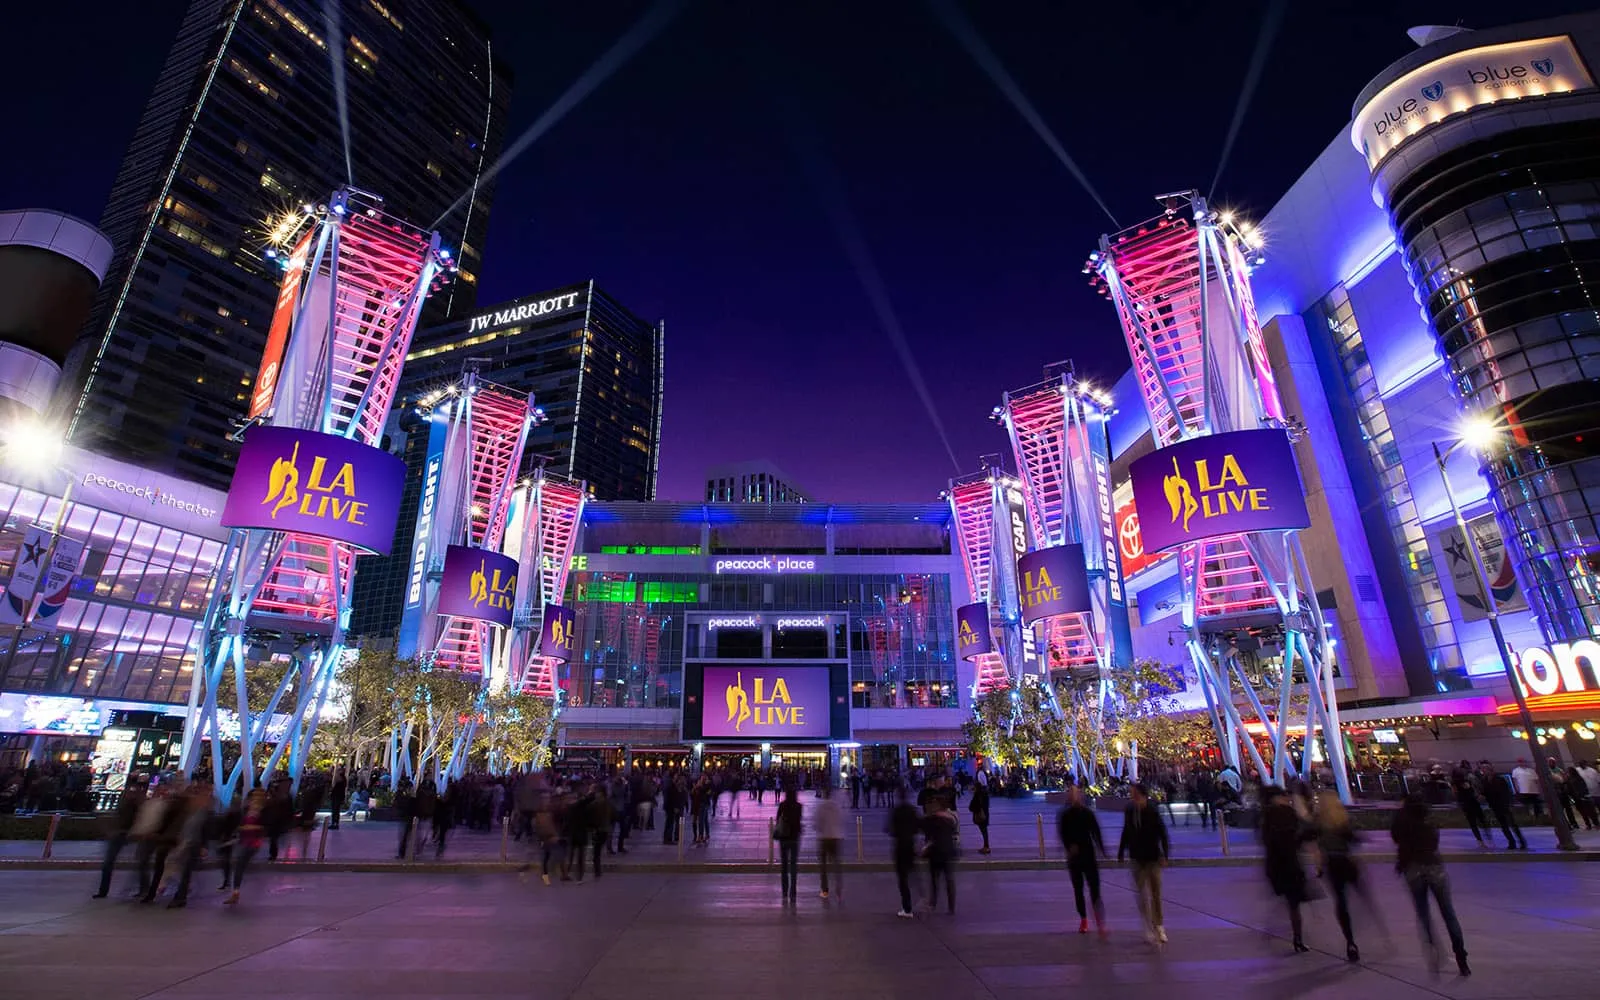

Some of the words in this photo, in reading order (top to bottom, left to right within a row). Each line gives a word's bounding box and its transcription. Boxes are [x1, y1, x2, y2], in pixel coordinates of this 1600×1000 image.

[1467, 65, 1528, 85] blue
[1484, 78, 1540, 90] california
[1374, 98, 1417, 136] blue
[1385, 107, 1429, 137] california
[468, 314, 493, 333] JW
[493, 292, 579, 326] MARRIOTT
[306, 456, 356, 497] LA
[1195, 454, 1249, 493] LA
[82, 473, 153, 501] peacock
[161, 492, 217, 518] theater
[299, 493, 368, 526] LIVE
[1094, 457, 1114, 539] LIGHT
[1201, 488, 1270, 518] LIVE
[409, 542, 426, 604] BUD
[418, 460, 439, 540] LIGHT
[716, 556, 771, 574] peacock
[777, 556, 815, 573] place
[1106, 542, 1122, 601] BUD
[1024, 567, 1053, 593] LA
[488, 593, 514, 611] LIV
[1027, 586, 1063, 609] LIVE
[708, 616, 756, 631] peacock
[777, 616, 825, 631] peacock
[959, 632, 981, 649] IVE
[753, 678, 792, 704] LA
[753, 707, 805, 725] LIVE
